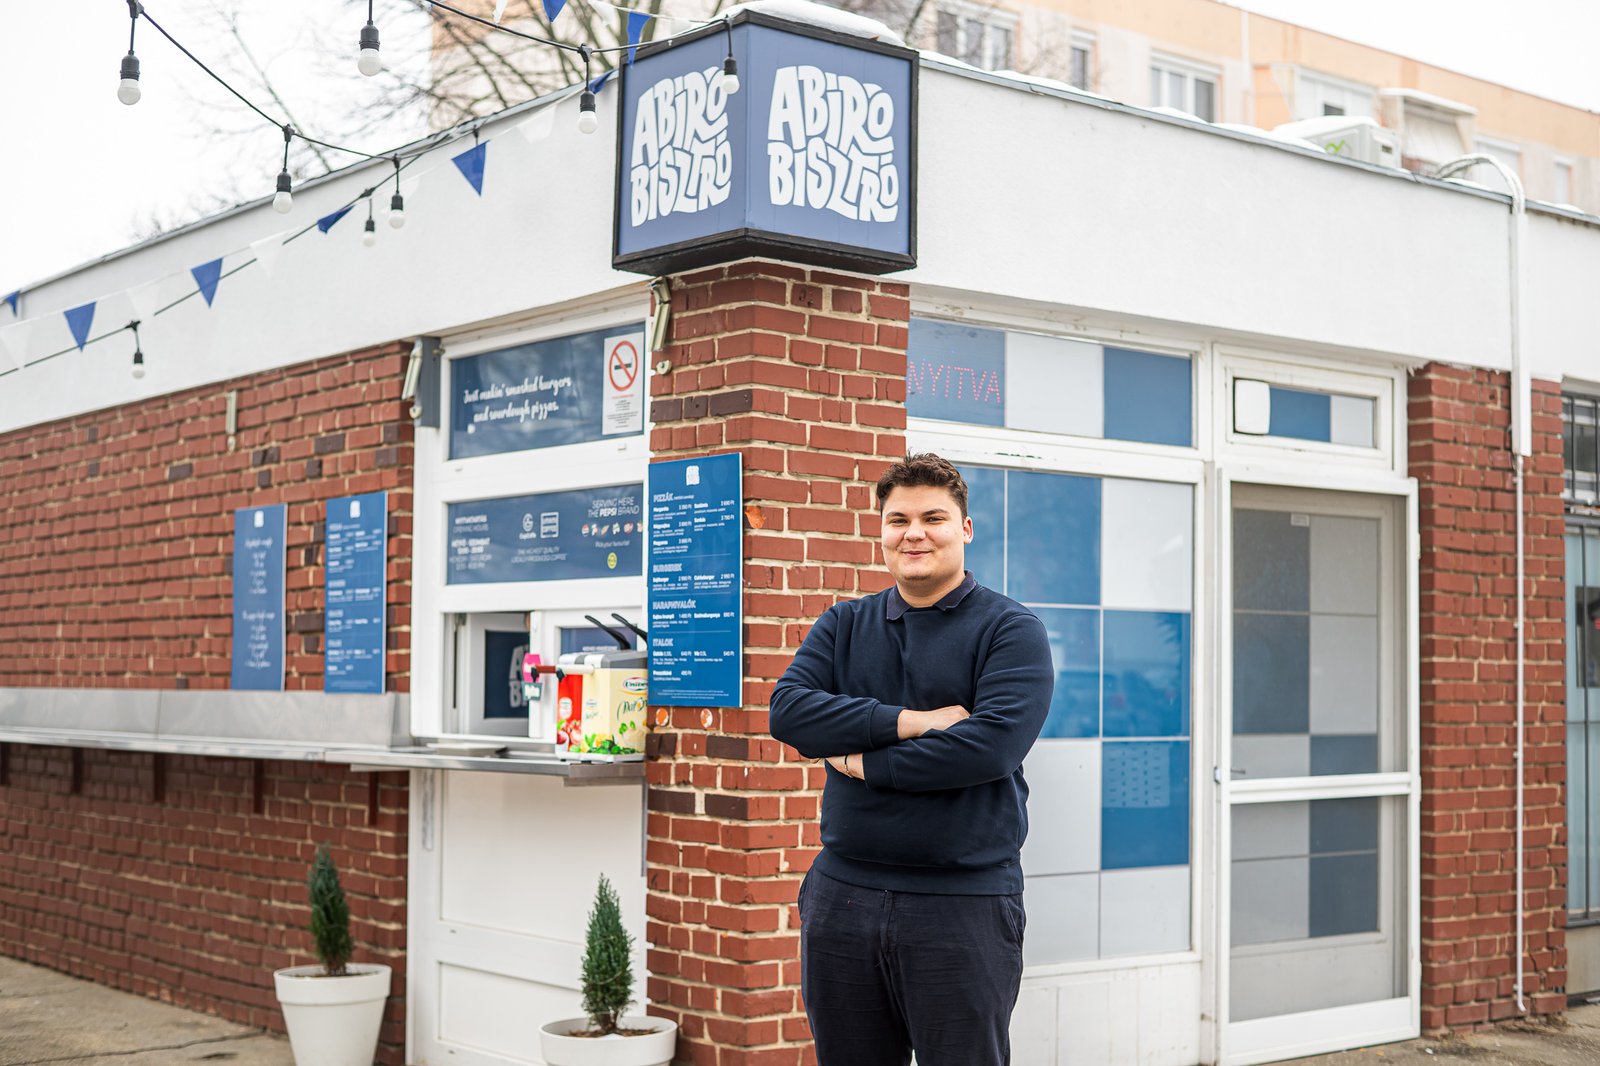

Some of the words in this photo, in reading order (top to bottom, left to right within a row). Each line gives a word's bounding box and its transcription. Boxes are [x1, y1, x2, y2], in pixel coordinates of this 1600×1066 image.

[505, 376, 538, 396] smashed
[539, 375, 571, 396] burgers
[907, 359, 1001, 403] NYITVA
[473, 405, 489, 423] and
[489, 399, 530, 423] sourdough
[587, 509, 599, 518] THE
[599, 507, 617, 517] PEPSI
[617, 505, 640, 516] BRAND
[592, 498, 617, 509] SERVING
[617, 496, 635, 506] HERE
